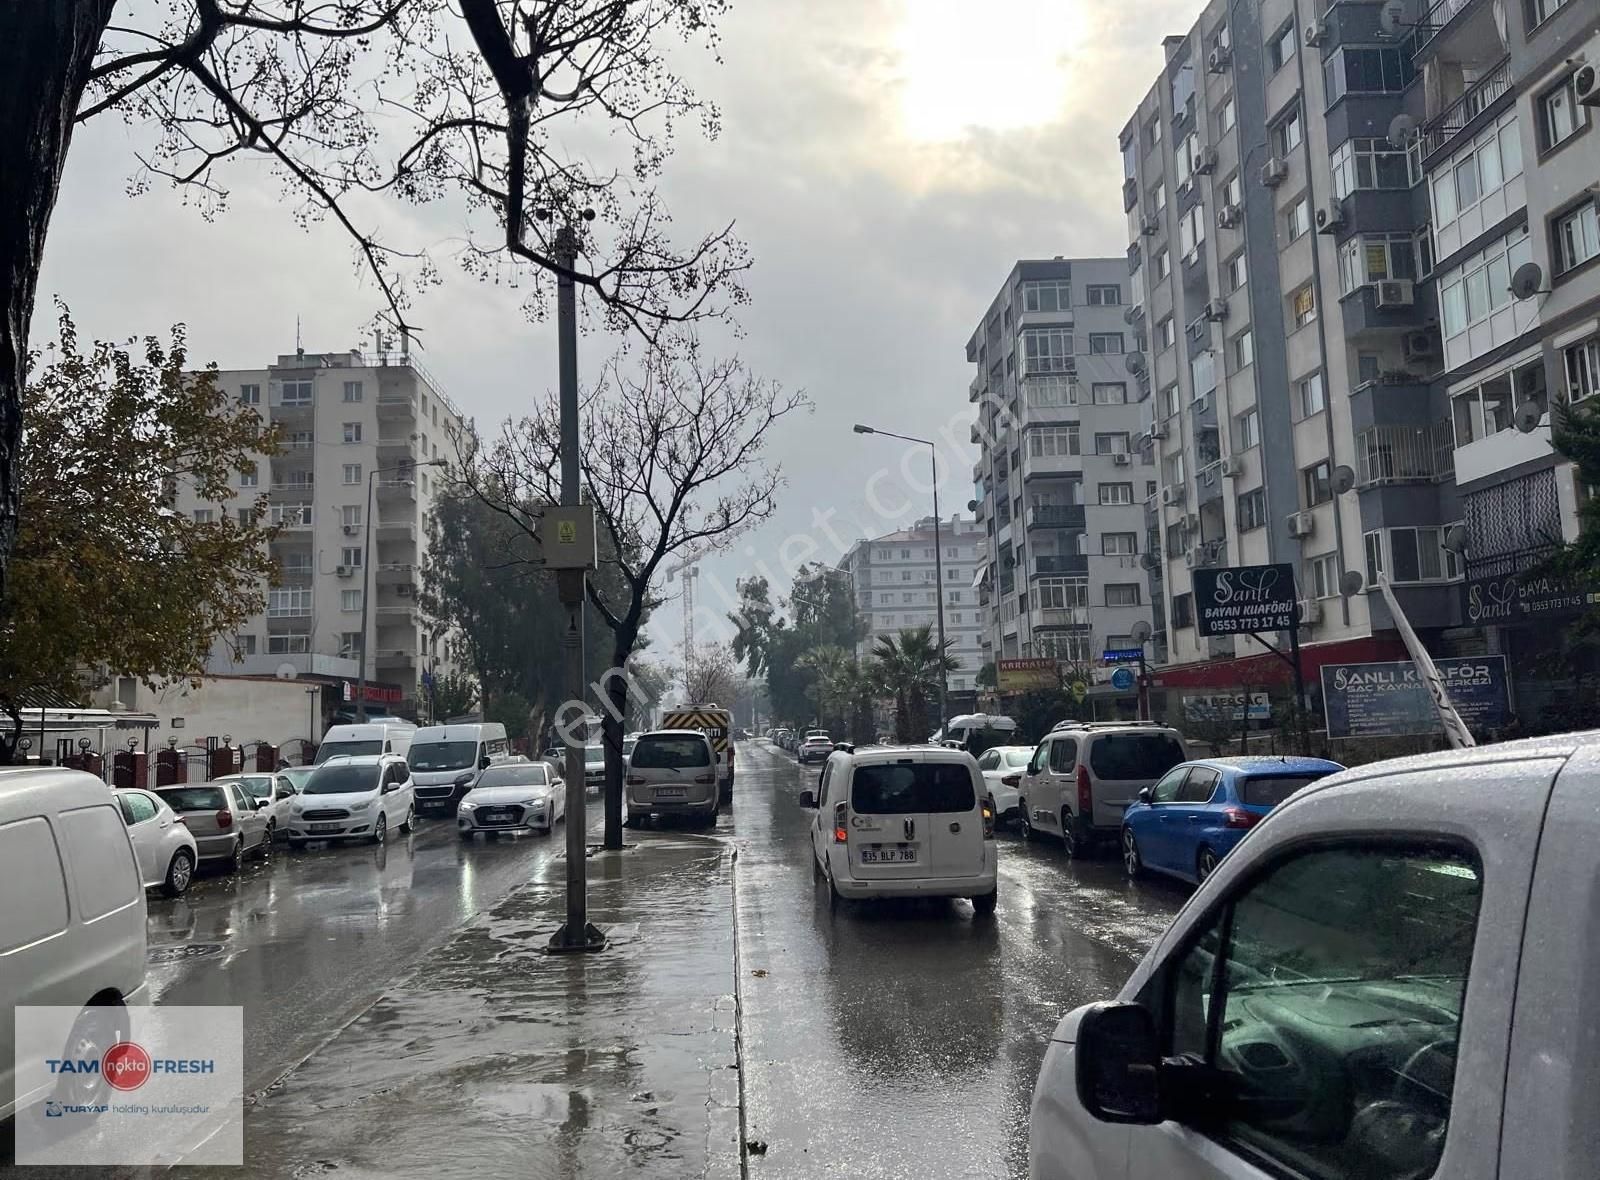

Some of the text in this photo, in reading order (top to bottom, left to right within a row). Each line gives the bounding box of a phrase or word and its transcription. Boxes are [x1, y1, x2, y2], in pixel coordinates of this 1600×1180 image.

[1519, 578, 1553, 598] BAYA
[1205, 600, 1293, 618] BAYAN KUAFÖRÜ
[1210, 615, 1290, 631] 0553 773 17 45
[868, 851, 878, 861] 35
